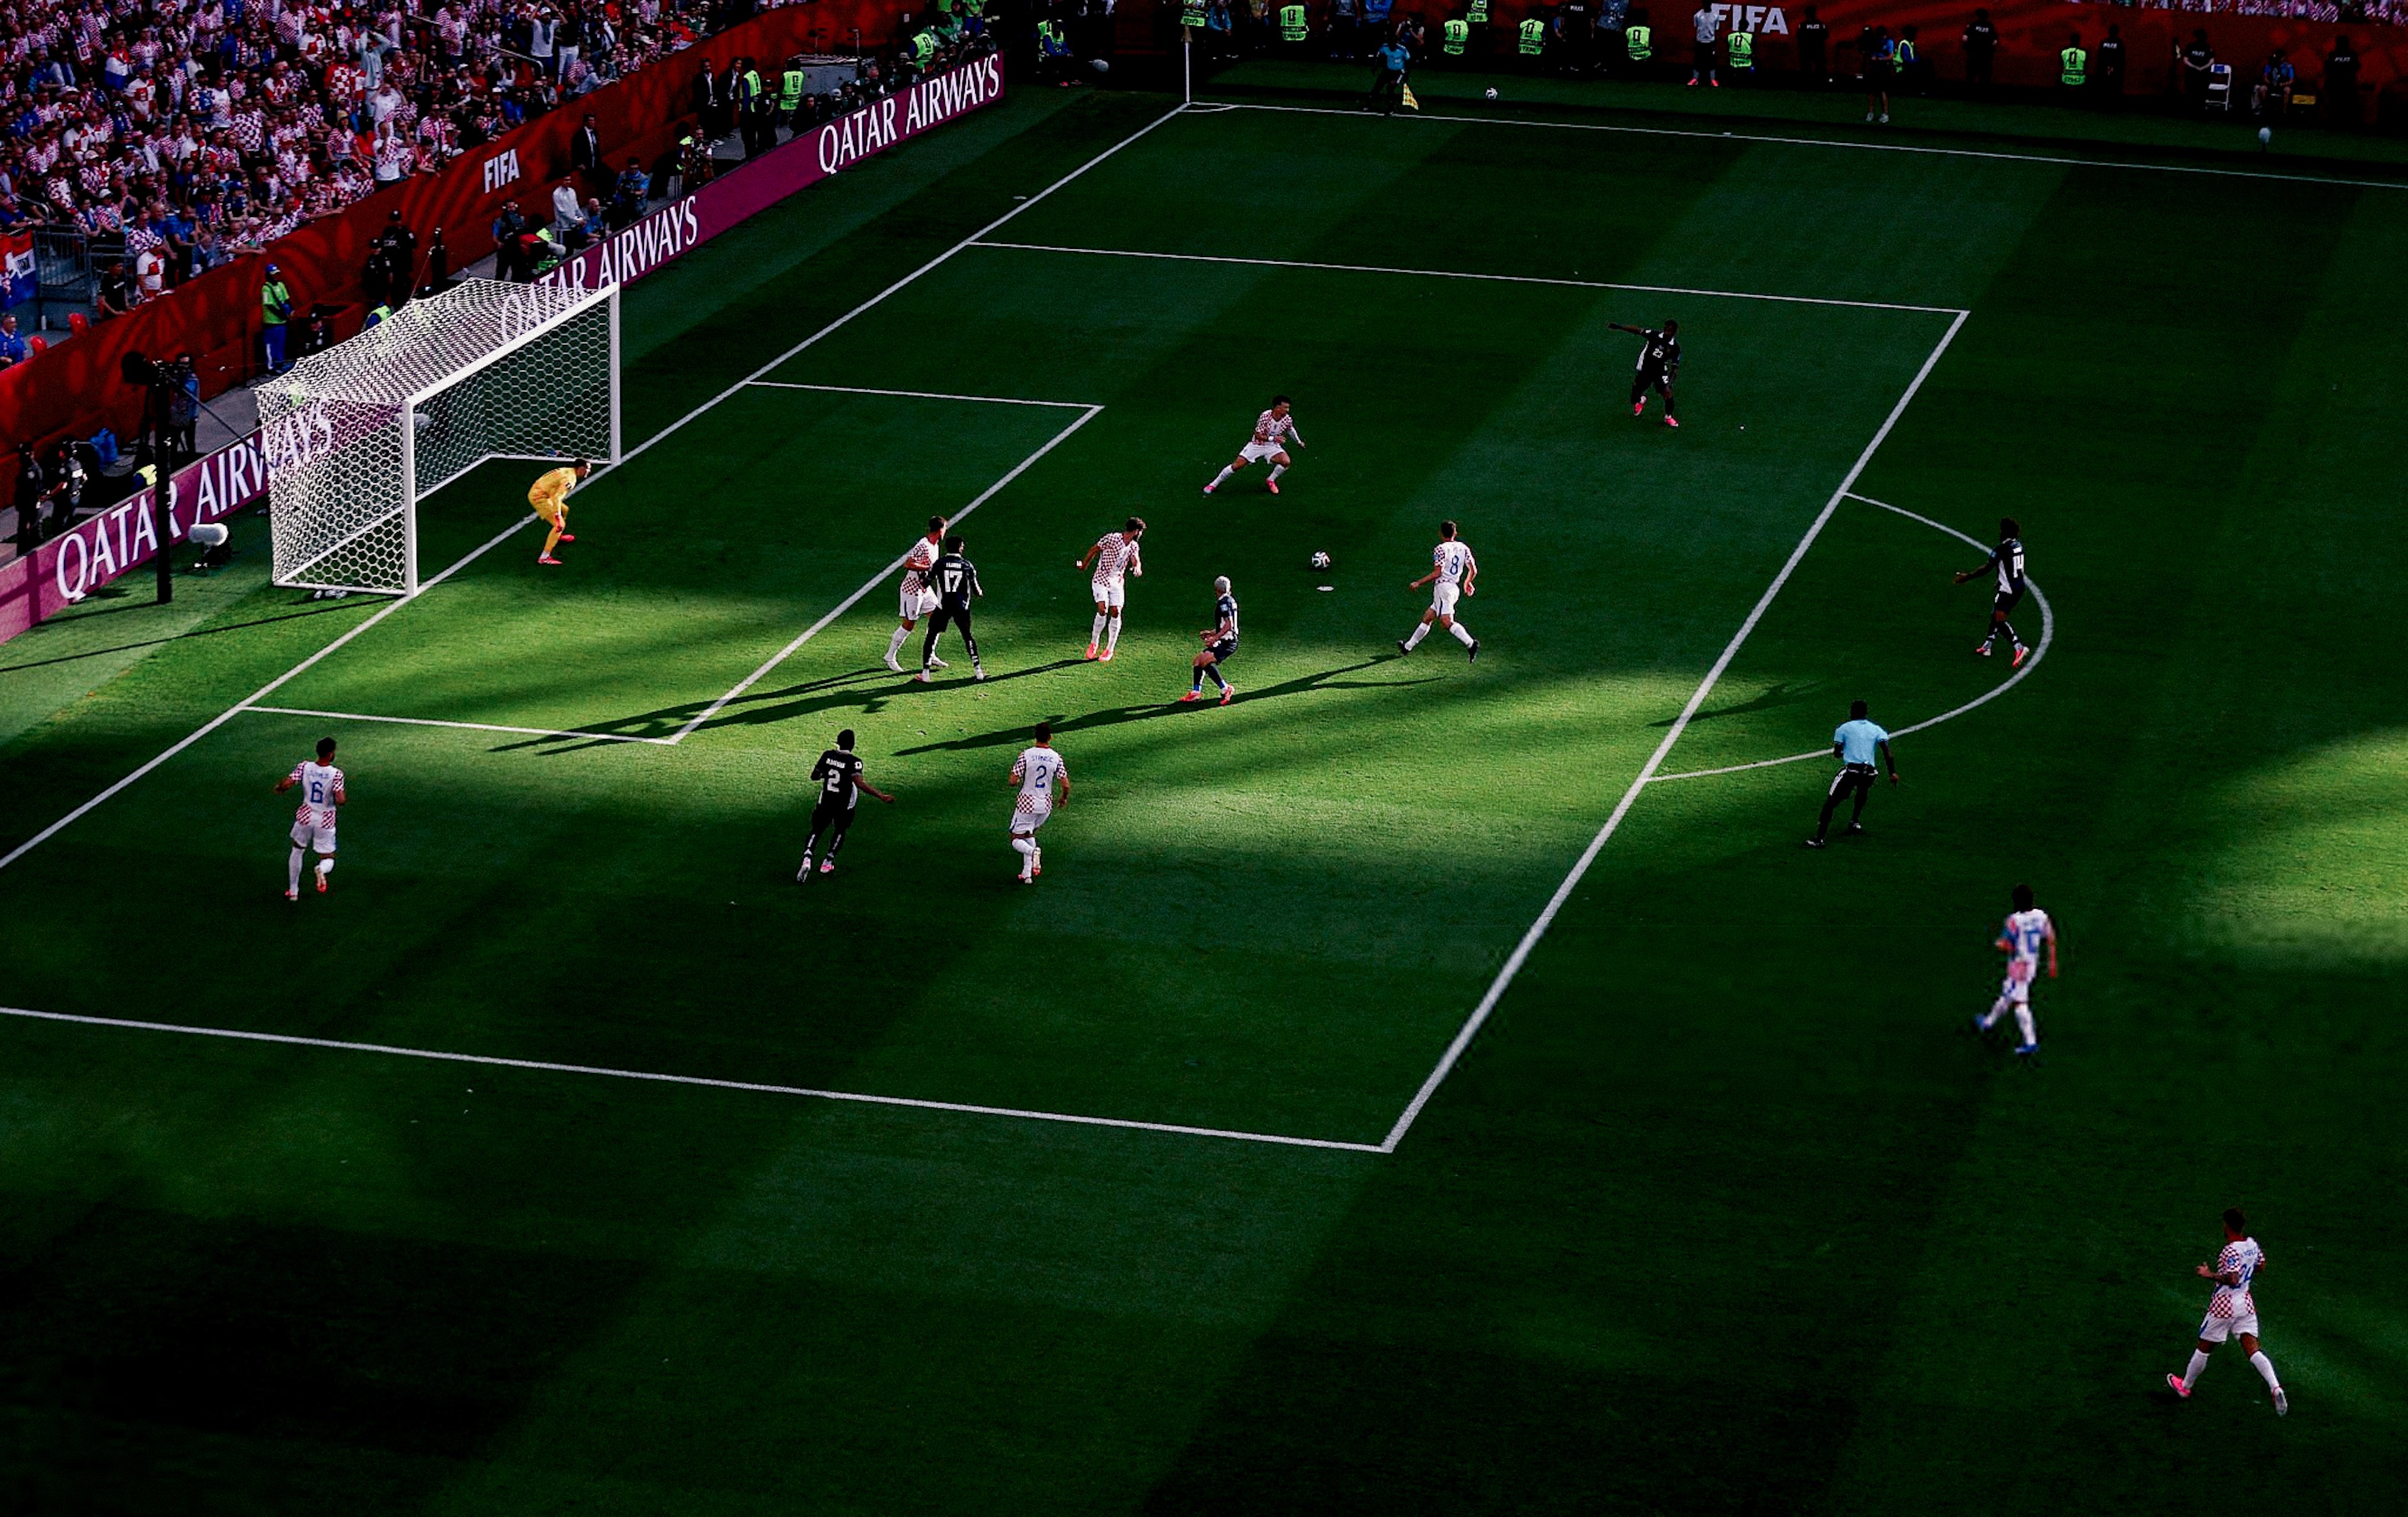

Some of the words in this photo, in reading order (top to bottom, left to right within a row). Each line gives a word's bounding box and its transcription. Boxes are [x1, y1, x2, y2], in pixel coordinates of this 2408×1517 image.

[1711, 3, 1789, 36] FIFA
[818, 98, 899, 175] QATAR
[906, 53, 1000, 135] AIRWAYS
[483, 148, 520, 194] FIFA
[598, 195, 698, 290] AIRWAYS
[1450, 555, 1459, 575] 8
[943, 569, 963, 593] 17
[826, 768, 841, 793] 2
[1035, 765, 1047, 788] 2
[311, 781, 323, 803] 6
